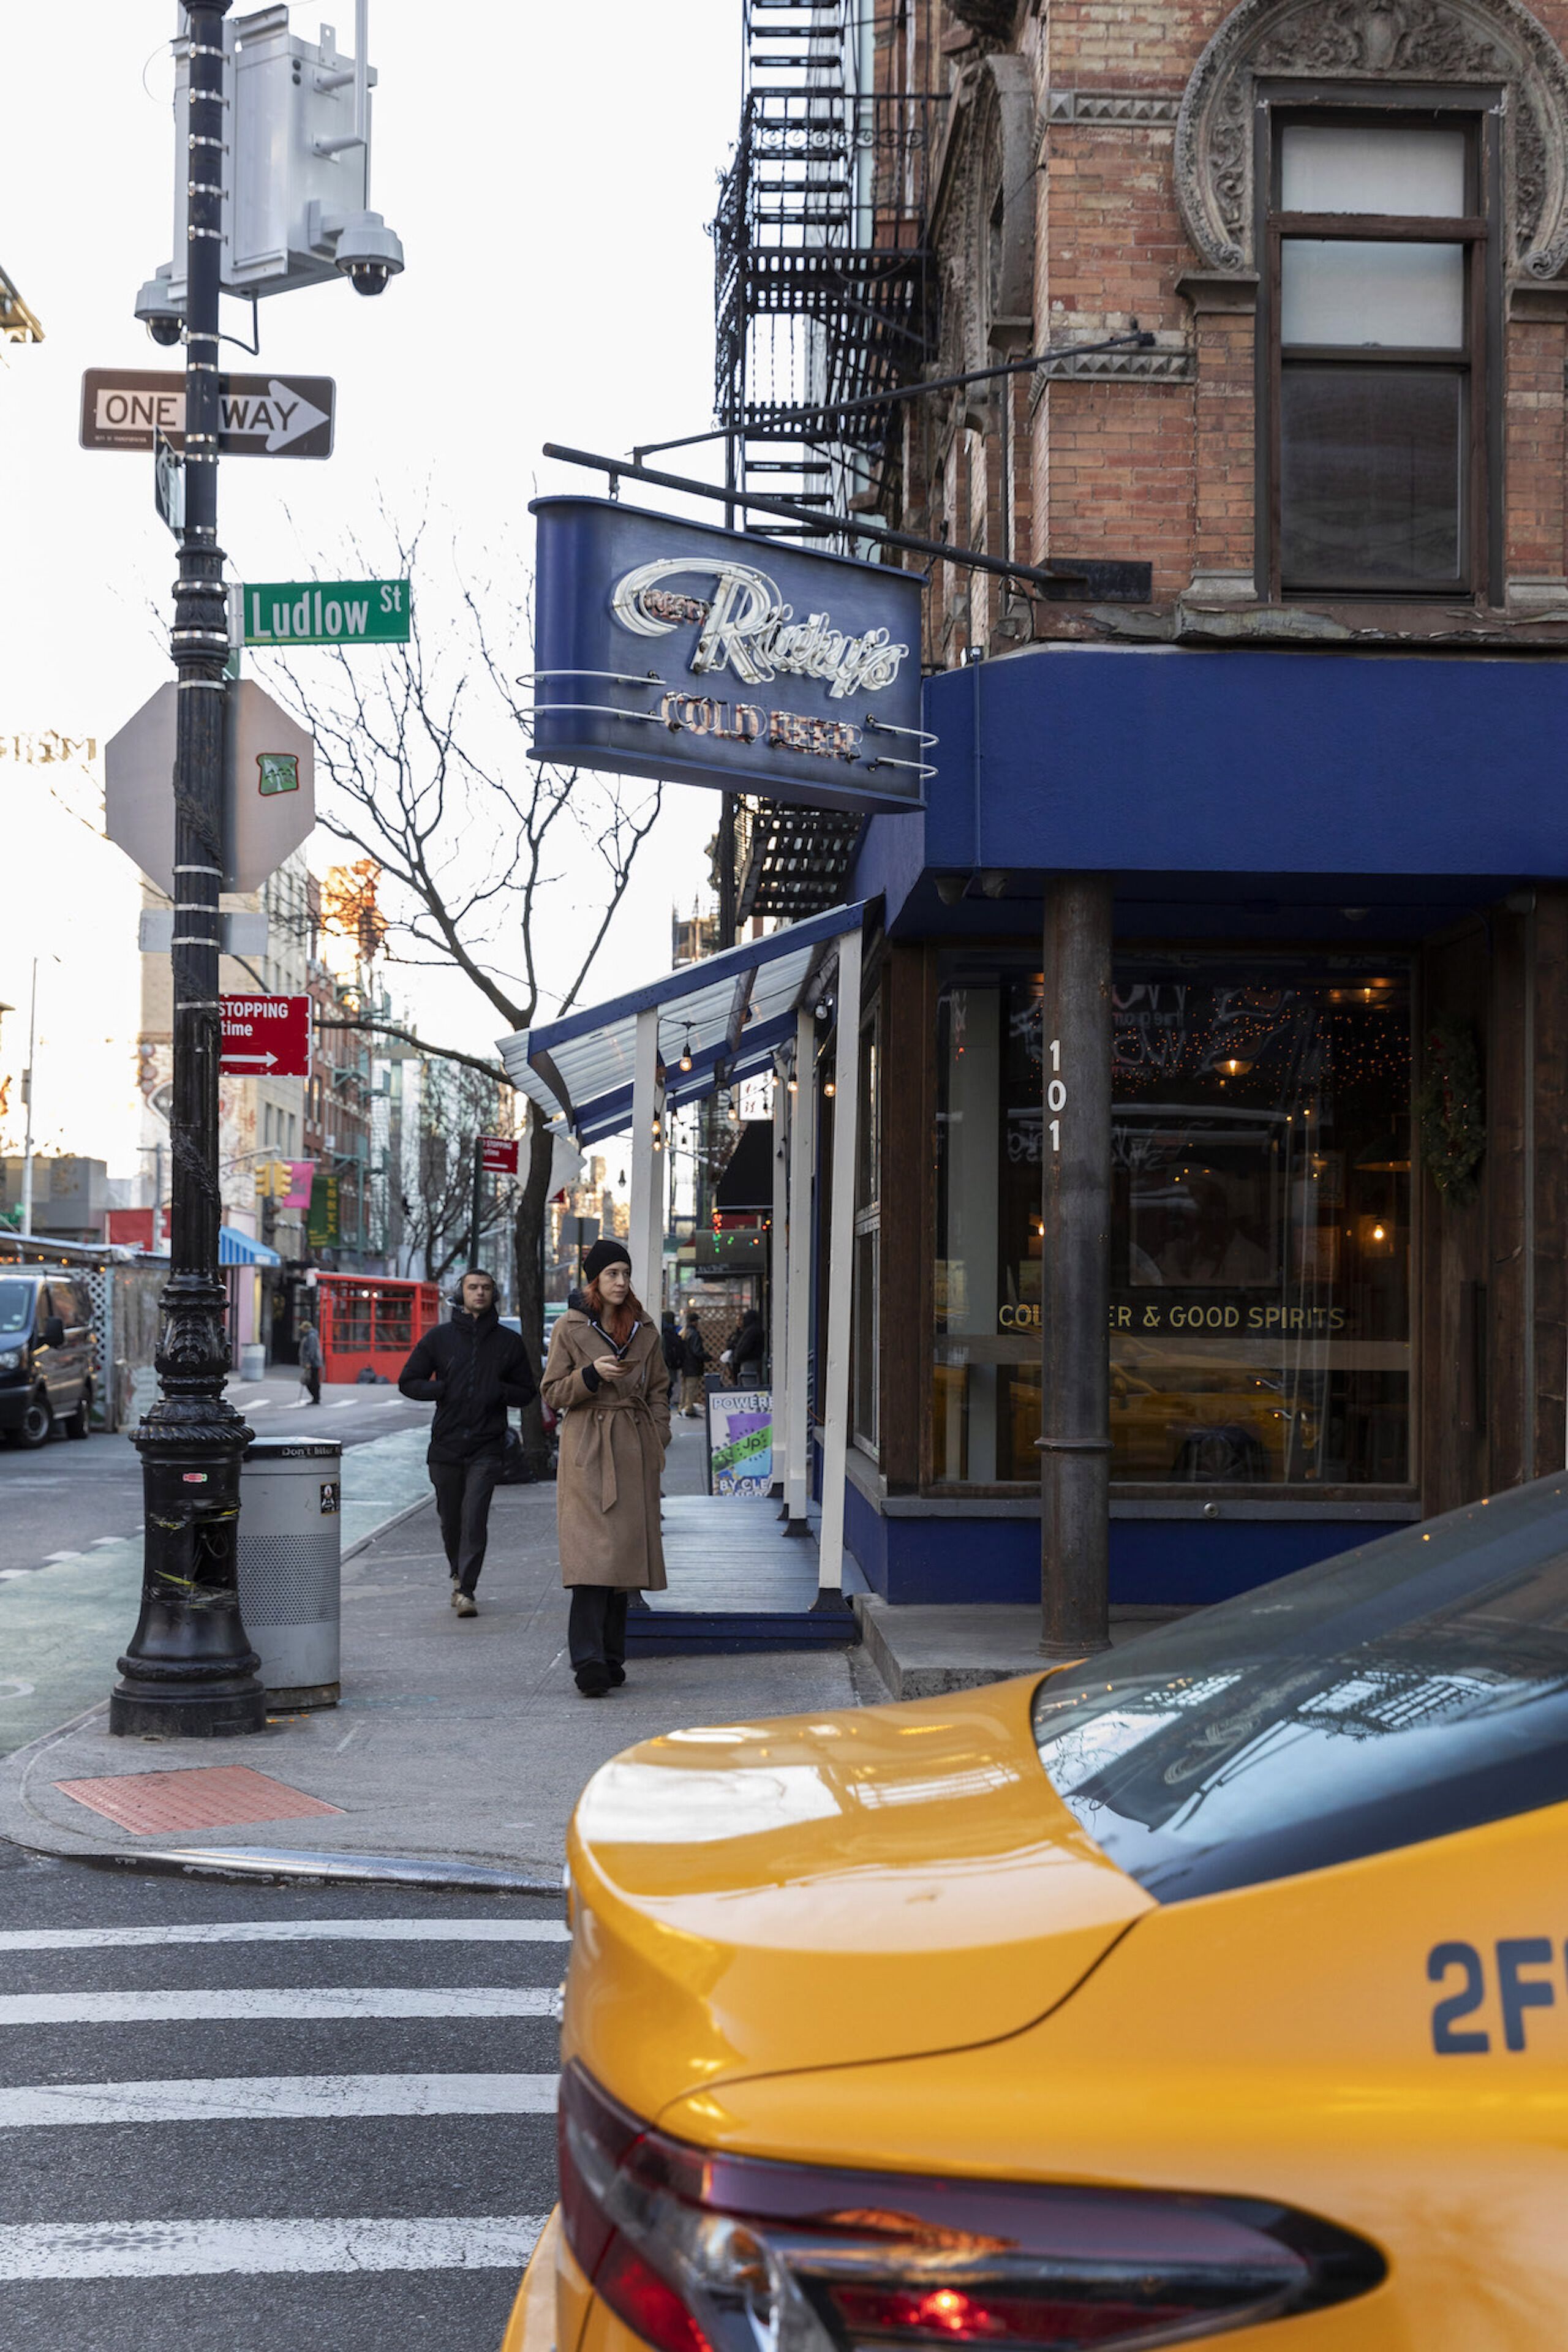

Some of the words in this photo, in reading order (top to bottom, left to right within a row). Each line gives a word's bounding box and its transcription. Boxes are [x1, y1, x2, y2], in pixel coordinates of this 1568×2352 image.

[105, 395, 177, 426] ONE
[221, 399, 299, 431] WAY
[252, 590, 369, 638] Ludlow
[380, 584, 401, 612] St
[661, 691, 767, 744] COLD
[770, 710, 863, 763] BEER
[219, 1001, 289, 1019] STOPPING
[221, 1020, 254, 1036] time
[1048, 1039, 1066, 1151] 101
[999, 1304, 1043, 1327] COL
[1143, 1305, 1161, 1327] &
[1169, 1305, 1240, 1328] GOOD
[1247, 1306, 1346, 1329] SPIRITS
[714, 1396, 774, 1409] POWERE
[720, 1479, 737, 1491] BY
[1427, 1937, 1568, 2056] 2F
